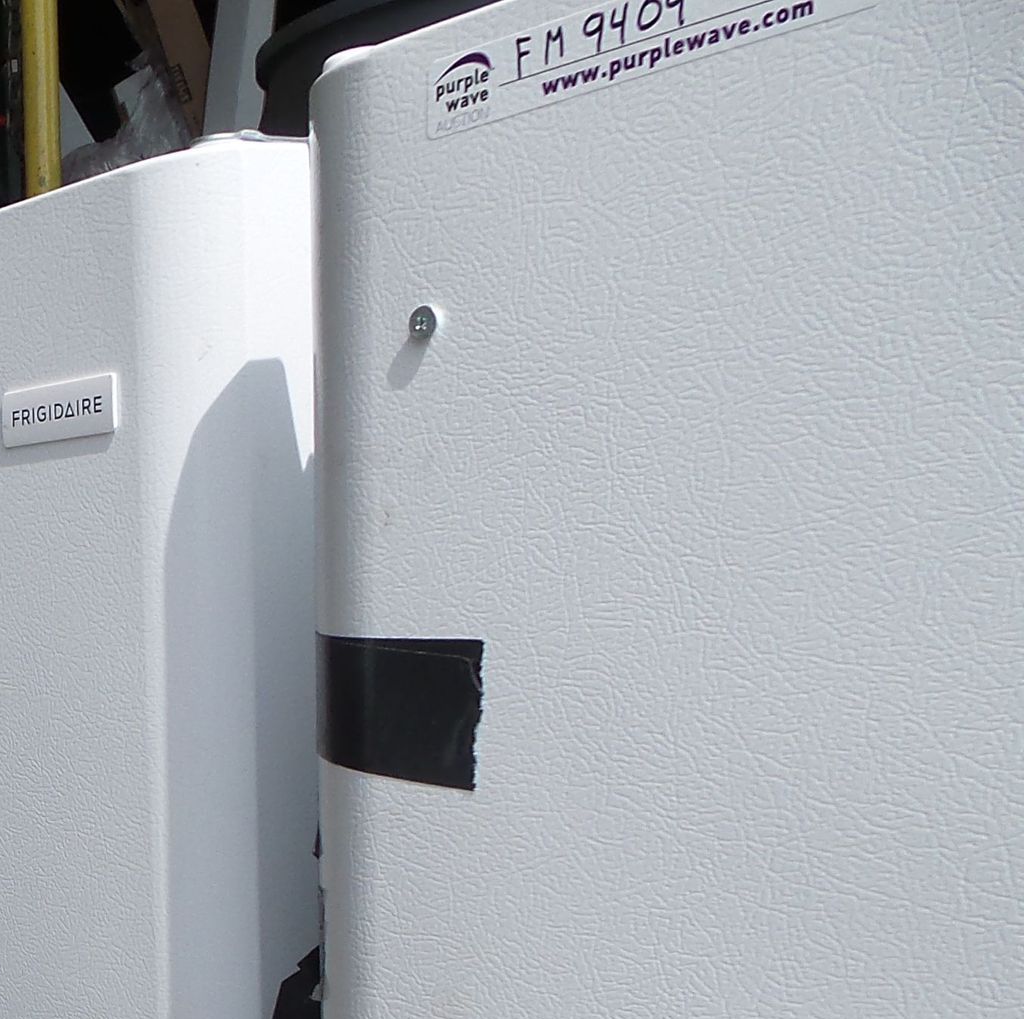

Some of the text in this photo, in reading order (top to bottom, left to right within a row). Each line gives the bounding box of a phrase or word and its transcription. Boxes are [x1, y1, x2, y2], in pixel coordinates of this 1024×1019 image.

[542, 0, 815, 95] www.purplewave.com
[436, 68, 489, 102] purple
[445, 89, 489, 112] wave
[12, 395, 103, 428] FRIGIDAIRE
